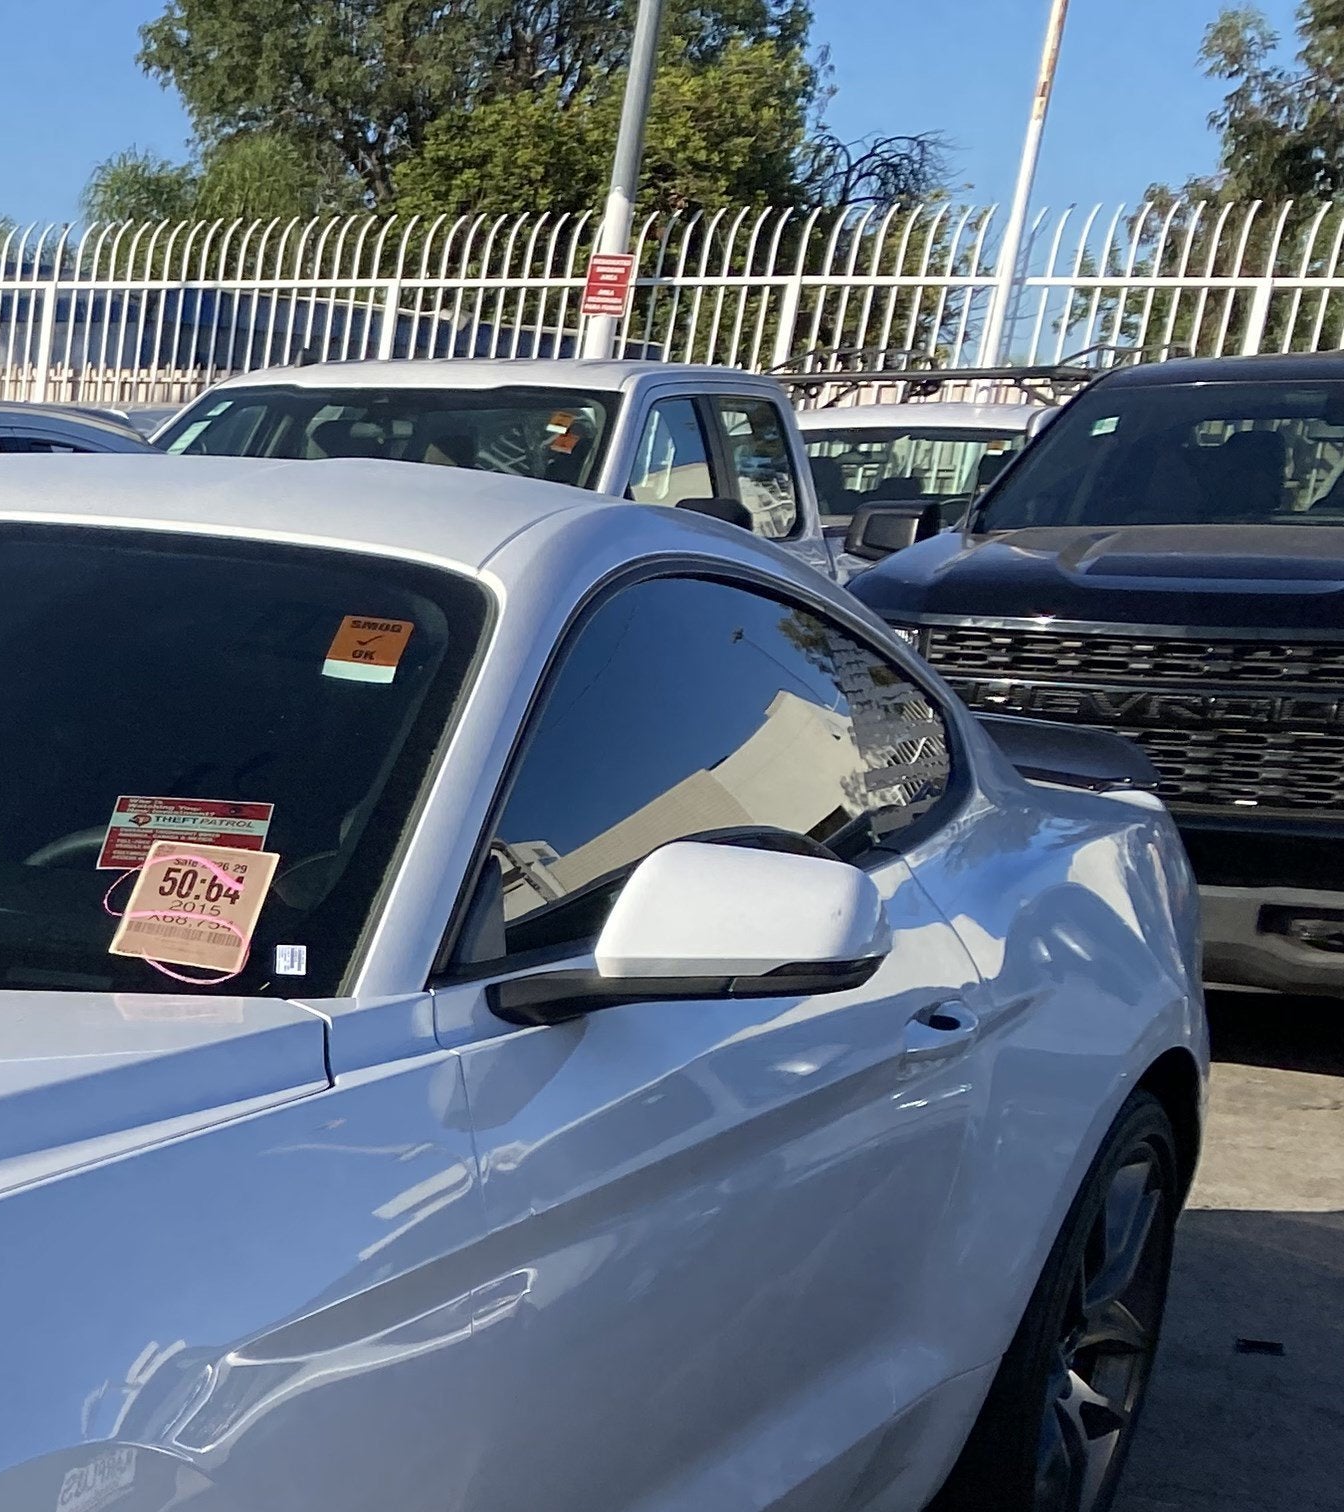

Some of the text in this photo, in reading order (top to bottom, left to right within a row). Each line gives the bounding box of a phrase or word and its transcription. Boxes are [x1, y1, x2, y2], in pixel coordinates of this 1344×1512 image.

[350, 619, 403, 633] SMOG
[351, 649, 376, 661] OK
[232, 863, 248, 874] 29
[158, 867, 245, 905] 50:64
[168, 899, 221, 917] 2015
